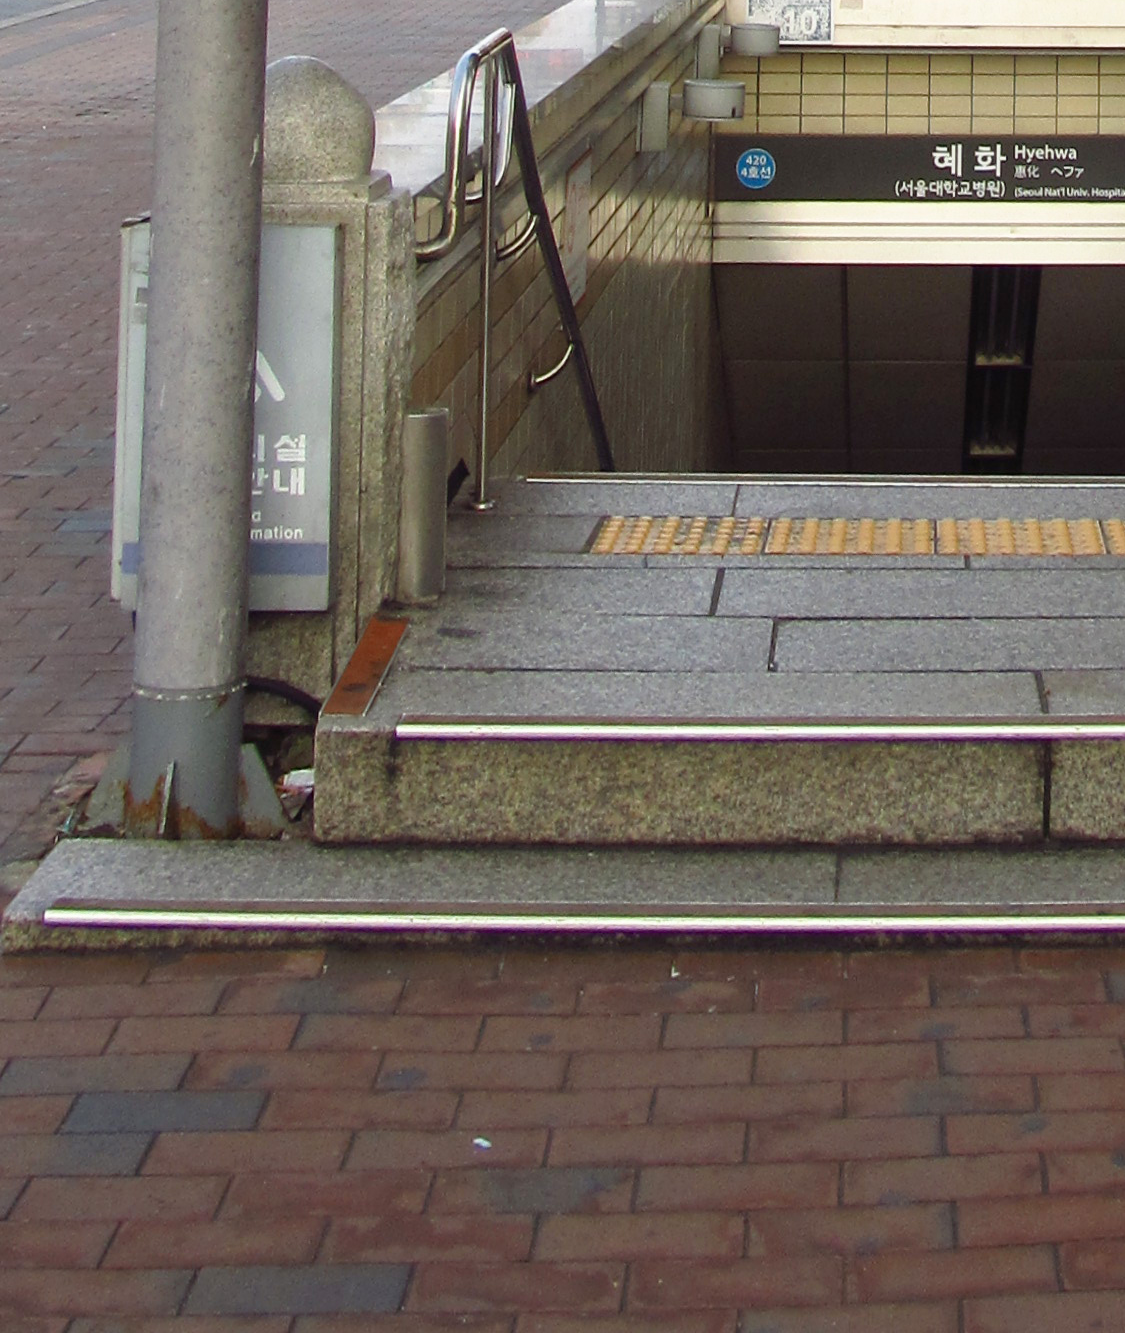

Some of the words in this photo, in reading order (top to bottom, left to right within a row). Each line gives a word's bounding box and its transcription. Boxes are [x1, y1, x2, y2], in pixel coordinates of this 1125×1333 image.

[745, 154, 767, 166] 420
[1014, 144, 1078, 163] Hyehwa
[894, 180, 1007, 199] (서울대학교병원)
[1014, 186, 1044, 199] (Seoul
[1067, 186, 1090, 198] Univ.
[249, 524, 304, 541] mation
